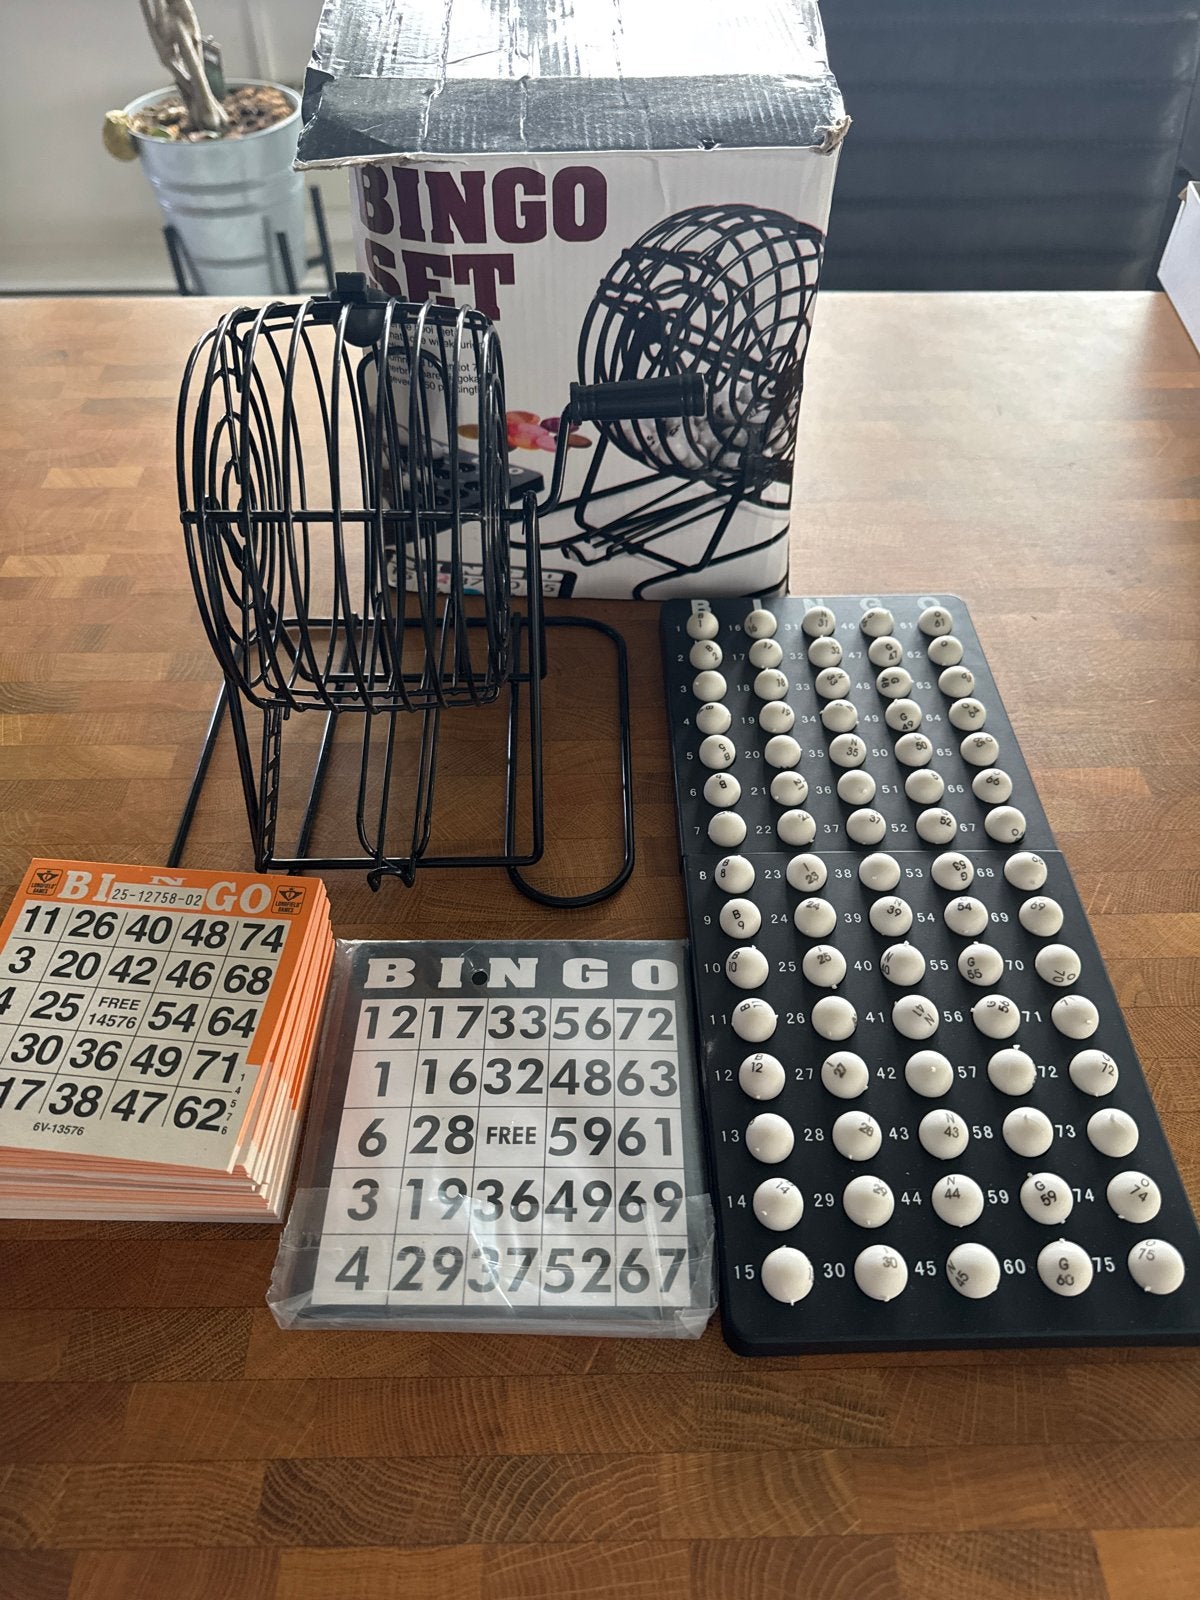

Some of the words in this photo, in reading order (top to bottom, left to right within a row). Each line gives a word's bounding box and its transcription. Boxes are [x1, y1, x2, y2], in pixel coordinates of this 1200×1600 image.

[360, 164, 607, 244] BINGO
[365, 238, 515, 321] SET
[785, 622, 798, 630] 31
[687, 752, 693, 760] 5
[872, 749, 888, 757] 50
[936, 748, 952, 756] 65
[751, 787, 765, 795] 21
[816, 786, 831, 794] 36
[882, 785, 897, 793] 51
[948, 785, 964, 793] 66
[756, 826, 771, 834] 22
[824, 825, 838, 833] 37
[891, 824, 907, 832] 52
[960, 823, 974, 832] 67
[700, 871, 706, 880] 8
[765, 870, 781, 878] 23
[835, 869, 851, 878] 38
[906, 869, 923, 877] 53
[977, 868, 994, 877] 68
[111, 888, 203, 907] 25-12758-02
[704, 916, 711, 925] 9
[771, 914, 787, 923] 24
[844, 913, 861, 923] 39
[917, 913, 934, 922] 54
[991, 913, 1008, 922] 69
[732, 909, 741, 920] B
[24, 905, 60, 935] 11
[68, 909, 118, 940] 26
[125, 914, 173, 945] 40
[182, 918, 230, 949] 48
[238, 923, 284, 953] 74
[738, 920, 745, 930] 9
[8, 946, 36, 974] 3
[50, 950, 101, 980] 20
[109, 954, 158, 985] 42
[166, 959, 215, 991] 46
[223, 964, 273, 995] 68
[705, 963, 720, 972] 10
[779, 962, 796, 972] 25
[854, 961, 872, 970] 40
[930, 960, 948, 970] 55
[1005, 960, 1024, 970] 70
[30, 991, 85, 1022] 25
[98, 996, 141, 1012] FREE
[148, 1000, 199, 1033] 54
[207, 1006, 256, 1039] 64
[88, 1012, 138, 1030] 14576
[710, 1015, 726, 1024] 11
[787, 1013, 805, 1024] 26
[866, 1012, 884, 1022] 41
[944, 1011, 963, 1022] 56
[1022, 1011, 1041, 1022] 71
[364, 1006, 418, 1040] 12
[428, 1006, 484, 1039] 17
[487, 1005, 547, 1039] 33
[552, 1006, 612, 1040] 56
[616, 1007, 674, 1041] 72
[11, 1032, 64, 1065] 30
[69, 1037, 123, 1071] 36
[130, 1043, 182, 1078] 49
[192, 1049, 240, 1084] 71
[374, 1061, 391, 1097] 1
[421, 1058, 478, 1095] 16
[483, 1058, 544, 1095] 32
[549, 1058, 612, 1096] 48
[617, 1060, 678, 1097] 63
[716, 1070, 732, 1081] 12
[795, 1068, 813, 1080] 27
[877, 1067, 896, 1079] 42
[958, 1066, 975, 1078] 57
[1038, 1066, 1058, 1077] 72
[0, 1077, 46, 1111] 17
[49, 1082, 103, 1118] 38
[111, 1089, 168, 1124] 47
[173, 1095, 227, 1132] 62
[230, 1099, 237, 1109] 5
[226, 1112, 233, 1121] 7
[32, 1122, 85, 1137] 6V-13576
[221, 1125, 228, 1135] 6
[357, 1118, 388, 1157] 6
[409, 1115, 475, 1155] 28
[486, 1126, 537, 1145] FREE
[548, 1117, 612, 1156] 59
[617, 1117, 673, 1156] 61
[722, 1130, 739, 1142] 13
[804, 1128, 824, 1141] 28
[889, 1127, 909, 1140] 43
[973, 1126, 993, 1139] 58
[1055, 1125, 1075, 1137] 73
[944, 1126, 960, 1139] 43
[1035, 1180, 1046, 1192] G
[347, 1178, 380, 1221] 3
[406, 1178, 468, 1220] 19
[474, 1179, 540, 1222] 36
[544, 1180, 613, 1223] 49
[618, 1180, 684, 1223] 69
[728, 1195, 746, 1208] 14
[814, 1193, 834, 1207] 29
[901, 1192, 921, 1205] 44
[988, 1190, 1008, 1204] 59
[1072, 1189, 1094, 1202] 74
[1040, 1190, 1057, 1207] 59
[335, 1247, 370, 1291] 4
[393, 1245, 464, 1291] 29
[467, 1247, 539, 1293] 37
[543, 1248, 612, 1293] 52
[619, 1248, 686, 1293] 67
[735, 1265, 754, 1279] 15
[824, 1263, 845, 1278] 30
[915, 1261, 936, 1275] 45
[1004, 1259, 1025, 1274] 60
[1092, 1257, 1115, 1272] 75
[1058, 1257, 1070, 1270] G
[1056, 1273, 1075, 1286] 60
